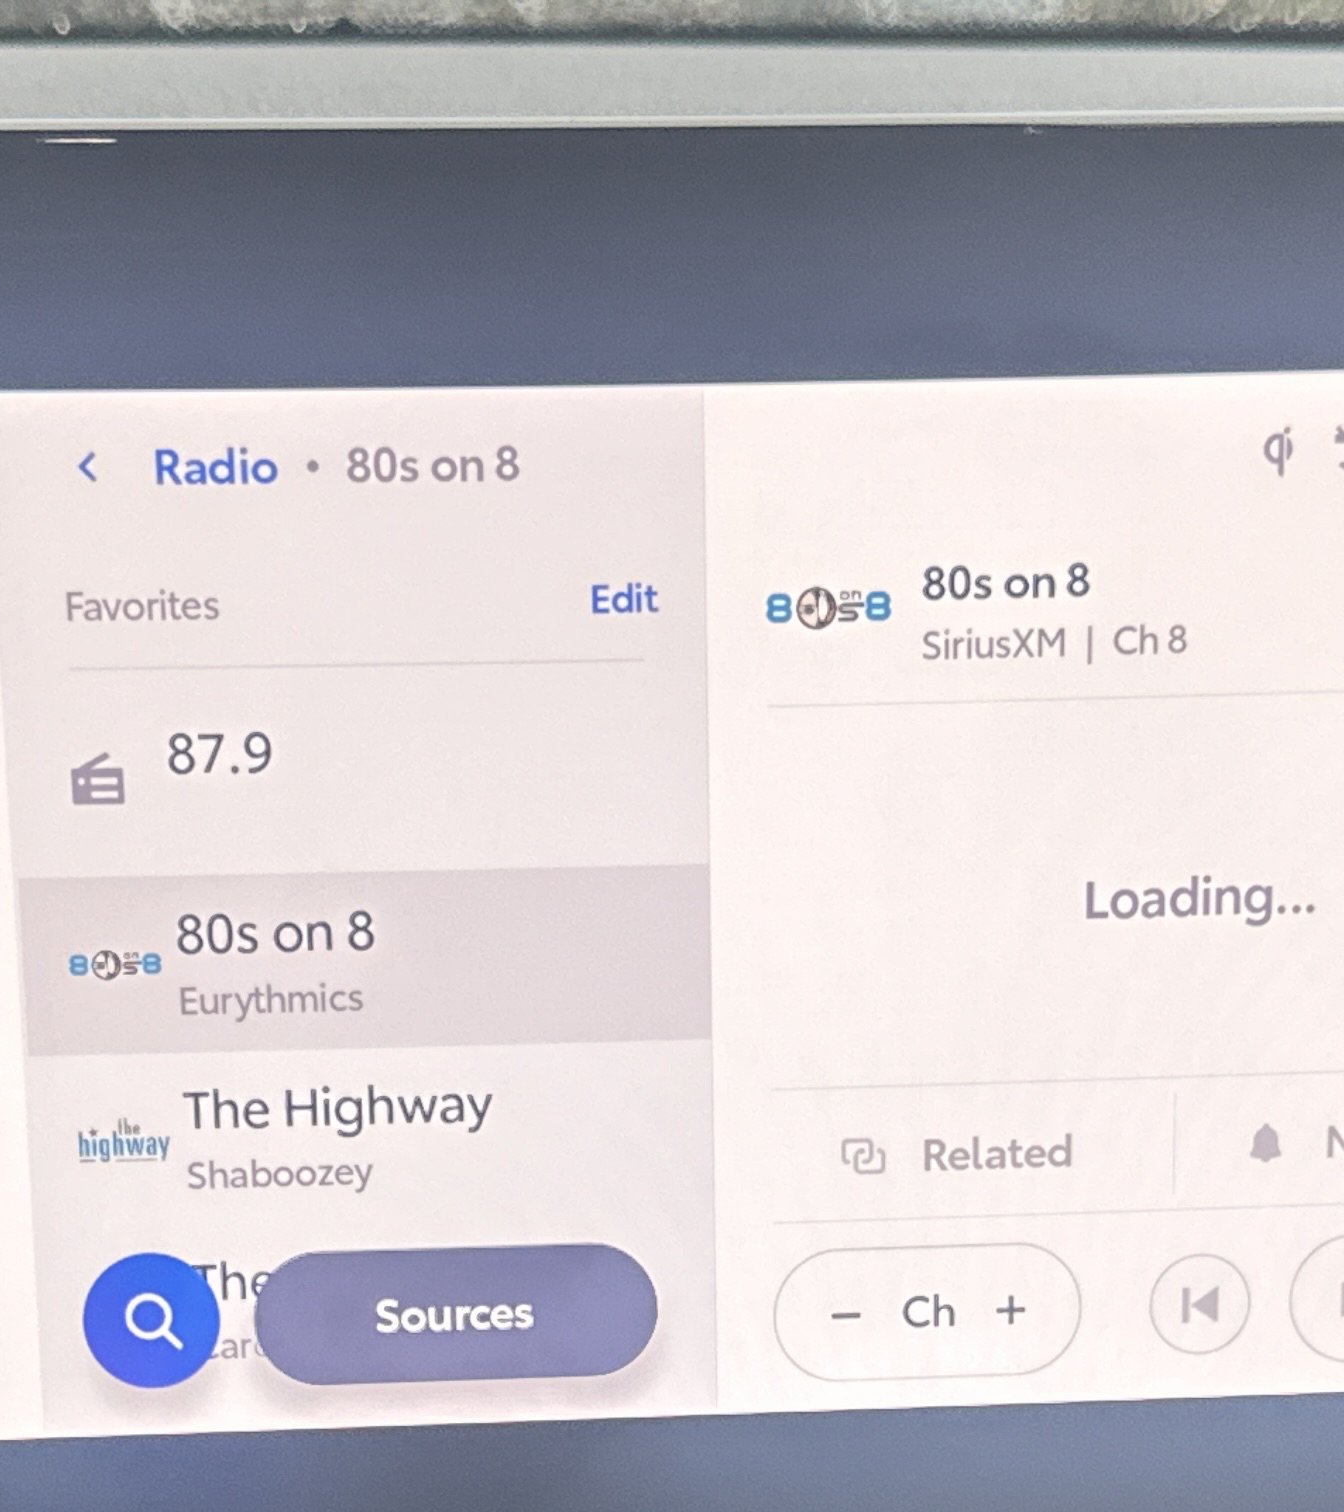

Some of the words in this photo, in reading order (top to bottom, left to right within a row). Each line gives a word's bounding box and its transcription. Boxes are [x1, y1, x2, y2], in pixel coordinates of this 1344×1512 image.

[155, 447, 278, 485] Radio
[347, 447, 419, 483] 80s
[431, 456, 484, 482] on
[496, 445, 520, 481] 8
[592, 583, 659, 614] Edit
[923, 565, 991, 600] 80s
[1004, 574, 1055, 598] on
[1067, 562, 1090, 597] 8
[66, 589, 220, 621] Favorites
[923, 628, 1065, 660] SiriusXM
[1113, 624, 1158, 655] Ch
[1168, 625, 1187, 654] 8
[168, 732, 271, 775] 87.9
[1086, 875, 1315, 926] Loading...
[178, 914, 258, 954] 80s
[274, 921, 332, 952] on
[348, 911, 374, 951] 8
[180, 983, 364, 1023] Eurythmics
[183, 1089, 269, 1129] The
[285, 1085, 492, 1137] Highway
[77, 1130, 171, 1162] highway
[924, 1133, 1072, 1171] Related
[188, 1159, 373, 1193] Shaboozey
[376, 1299, 534, 1333] Sources
[903, 1294, 955, 1328] Ch
